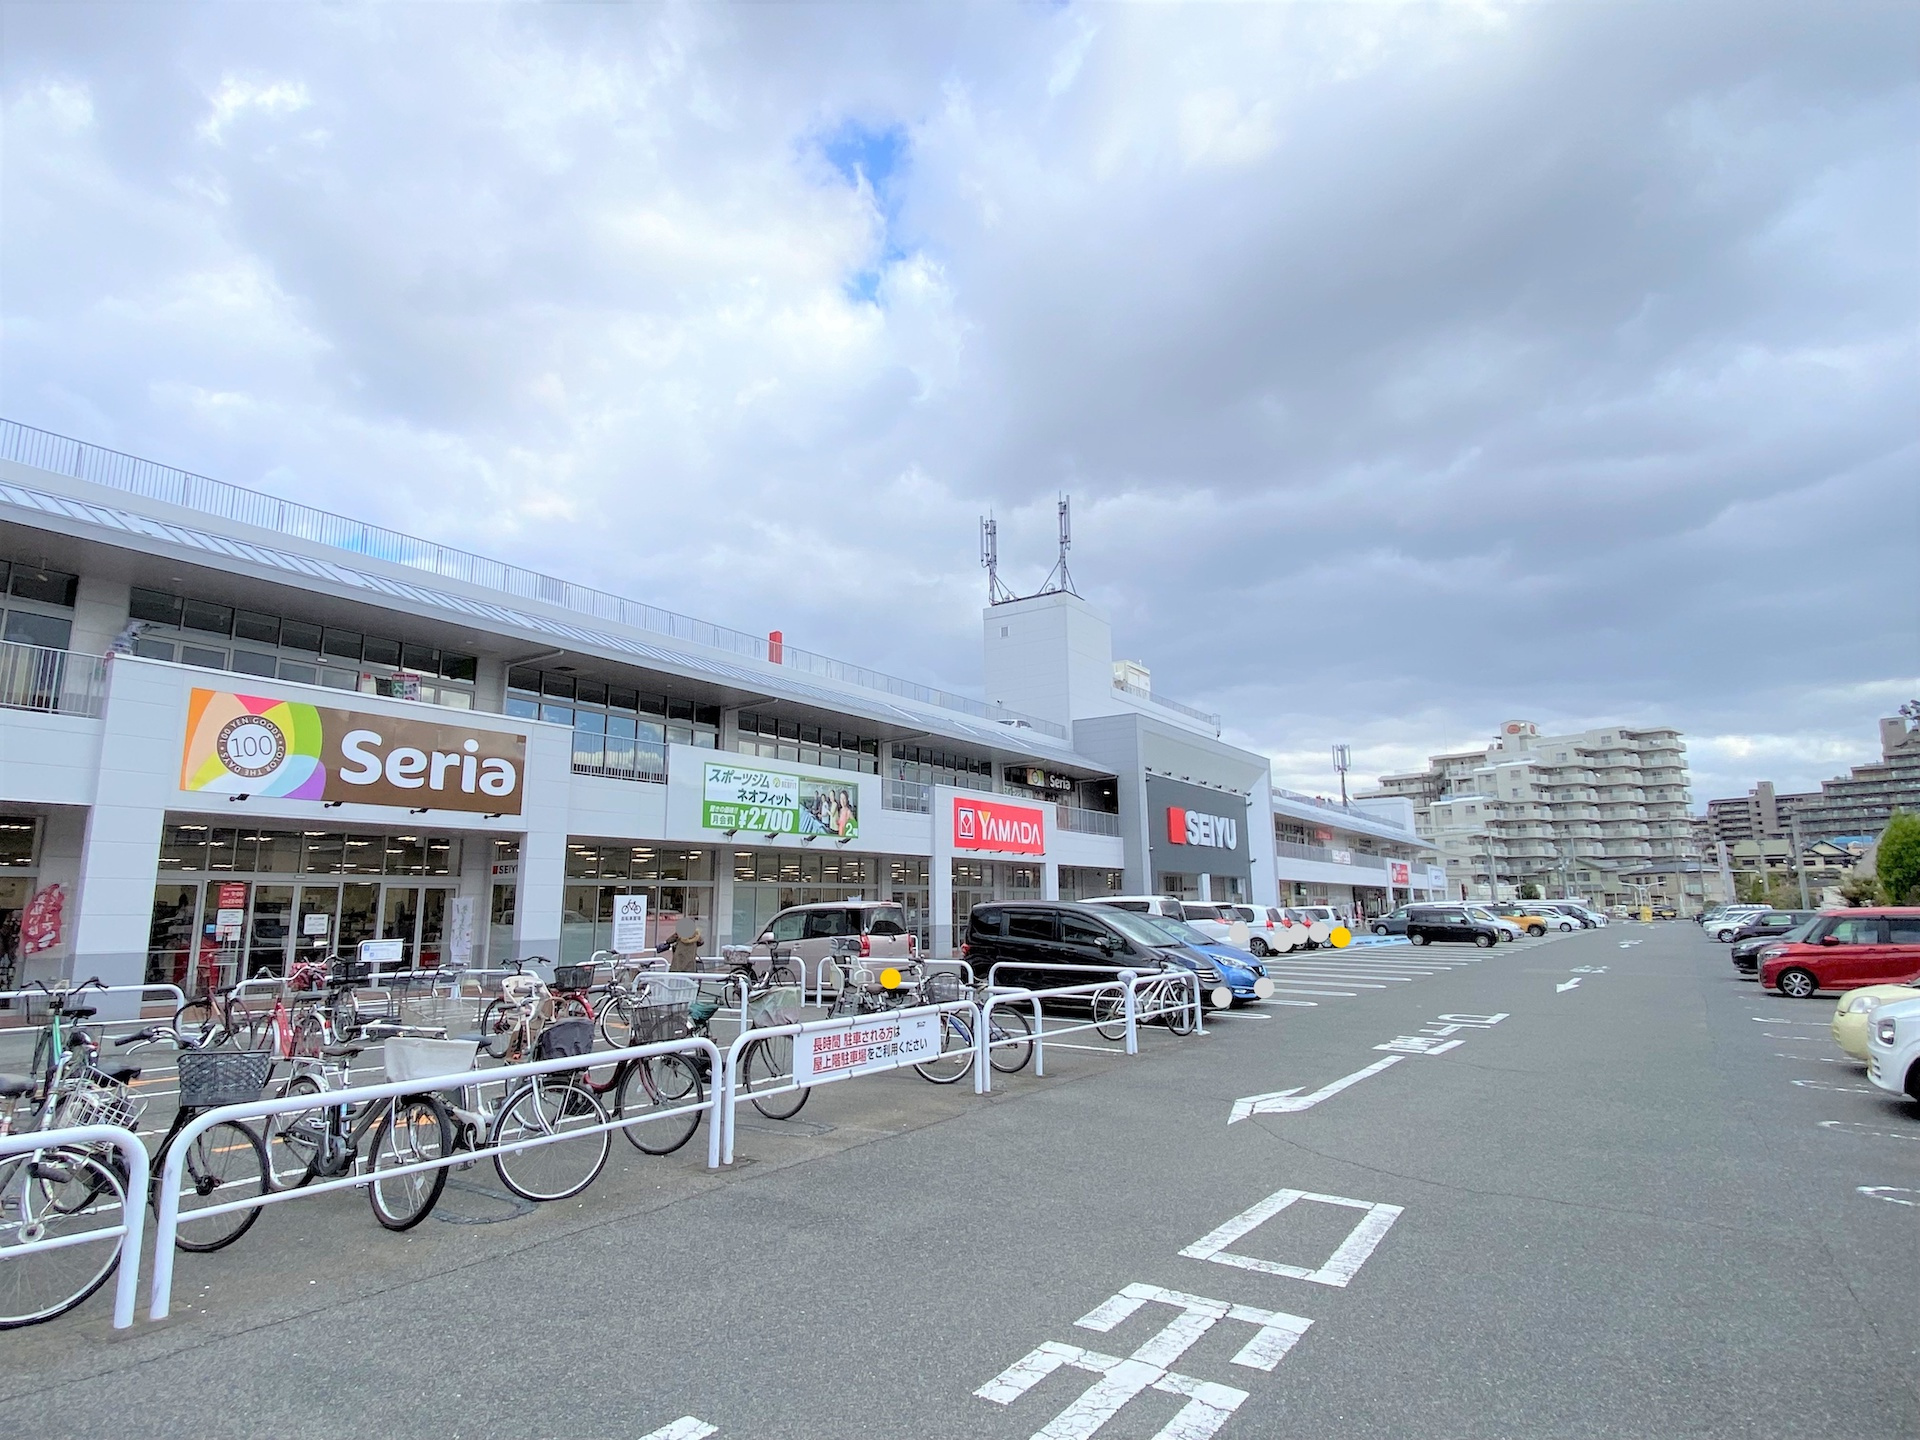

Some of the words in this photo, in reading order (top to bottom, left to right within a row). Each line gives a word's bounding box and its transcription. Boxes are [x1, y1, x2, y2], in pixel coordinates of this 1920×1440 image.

[231, 717, 249, 729] YEN
[252, 717, 282, 739] GOODS
[231, 735, 273, 758] 100
[220, 751, 241, 773] DAYS
[266, 747, 285, 773] COLOR
[339, 729, 517, 797] Seria
[244, 768, 263, 776] THE
[708, 768, 770, 789] スポーツジム
[1049, 774, 1072, 791] Seria
[737, 788, 792, 807] ネオフィット
[712, 814, 734, 826] 月会費
[738, 806, 793, 832] ¥2,700
[977, 809, 1041, 846] YAMADA
[1185, 810, 1237, 850] SEIYU
[813, 1033, 841, 1053] 長時間
[843, 1025, 901, 1047] 駐車される方は
[812, 1038, 928, 1072] 屋上階駐車場をご利用ください
